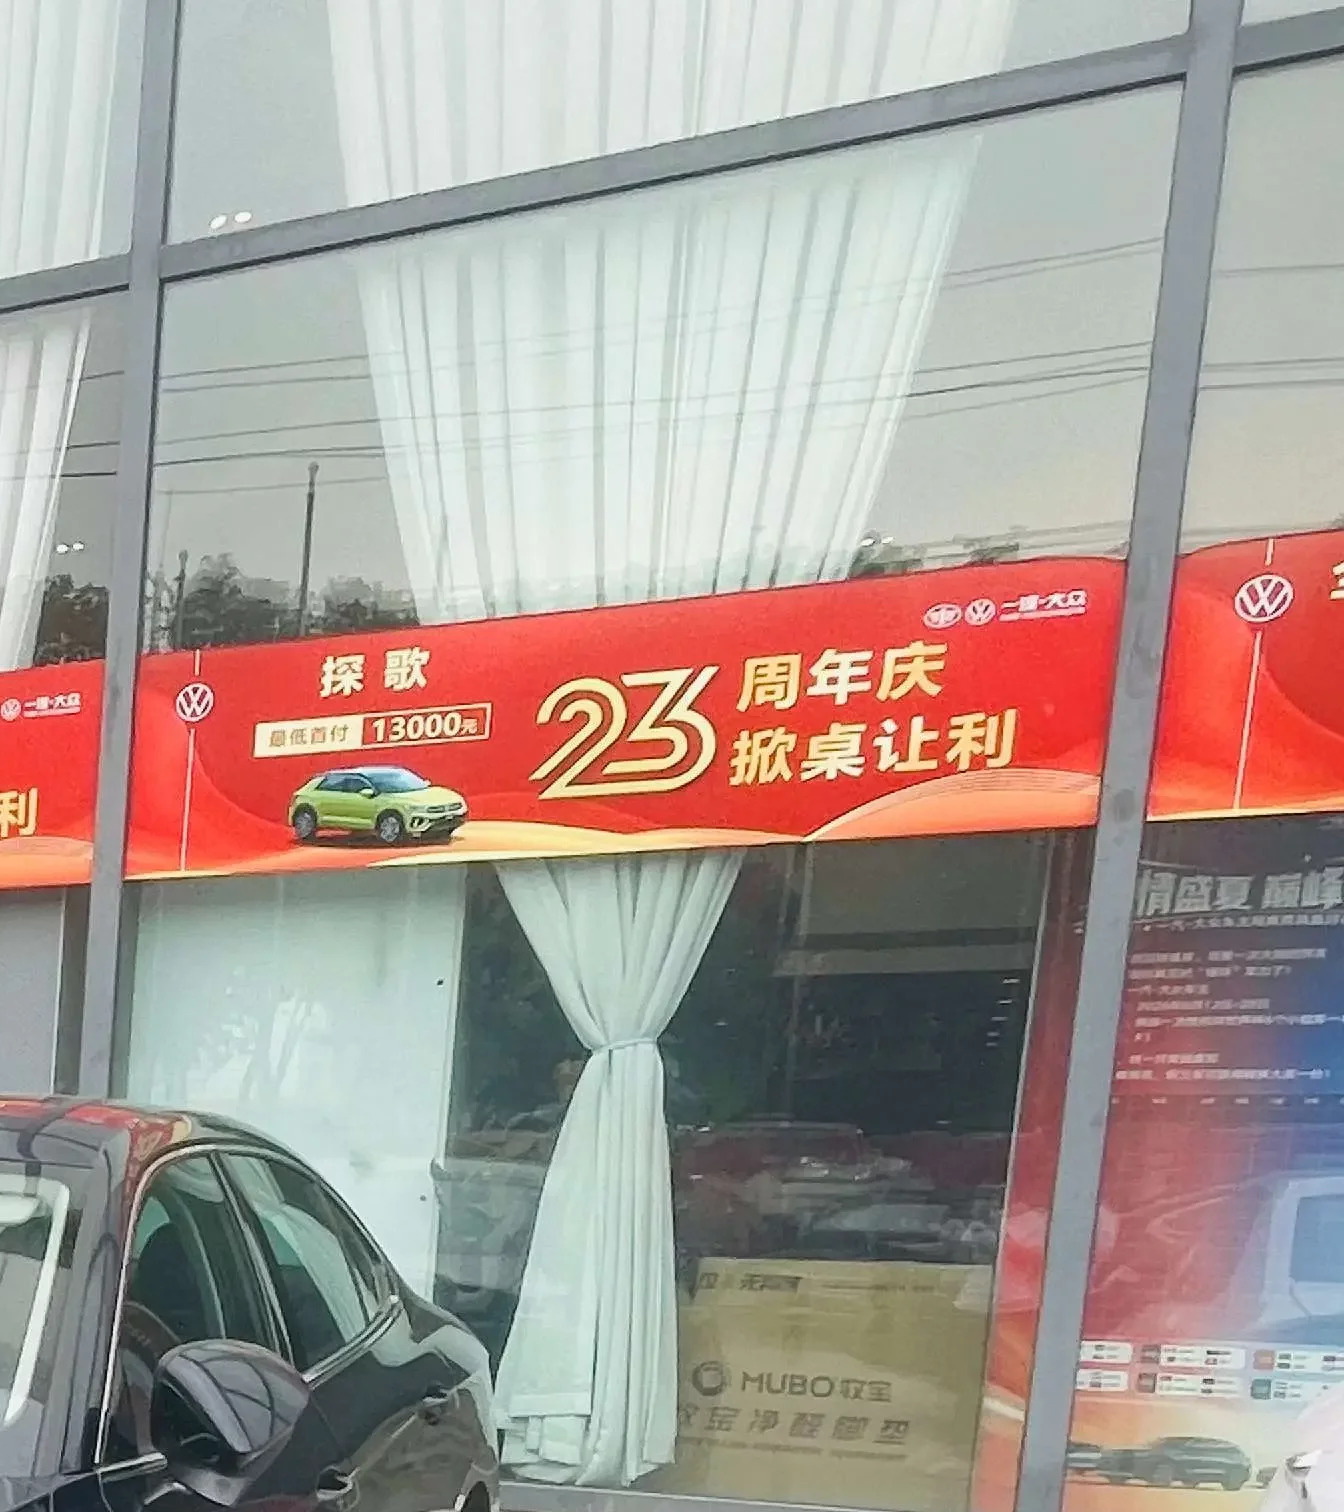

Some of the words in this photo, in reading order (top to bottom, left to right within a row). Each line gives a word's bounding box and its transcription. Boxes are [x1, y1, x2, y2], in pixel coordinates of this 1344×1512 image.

[319, 647, 430, 698] 探歌
[737, 641, 948, 713] 周年庆
[372, 712, 479, 743] 13000元
[529, 665, 719, 801] 23
[729, 708, 1018, 787] 掀桌让利
